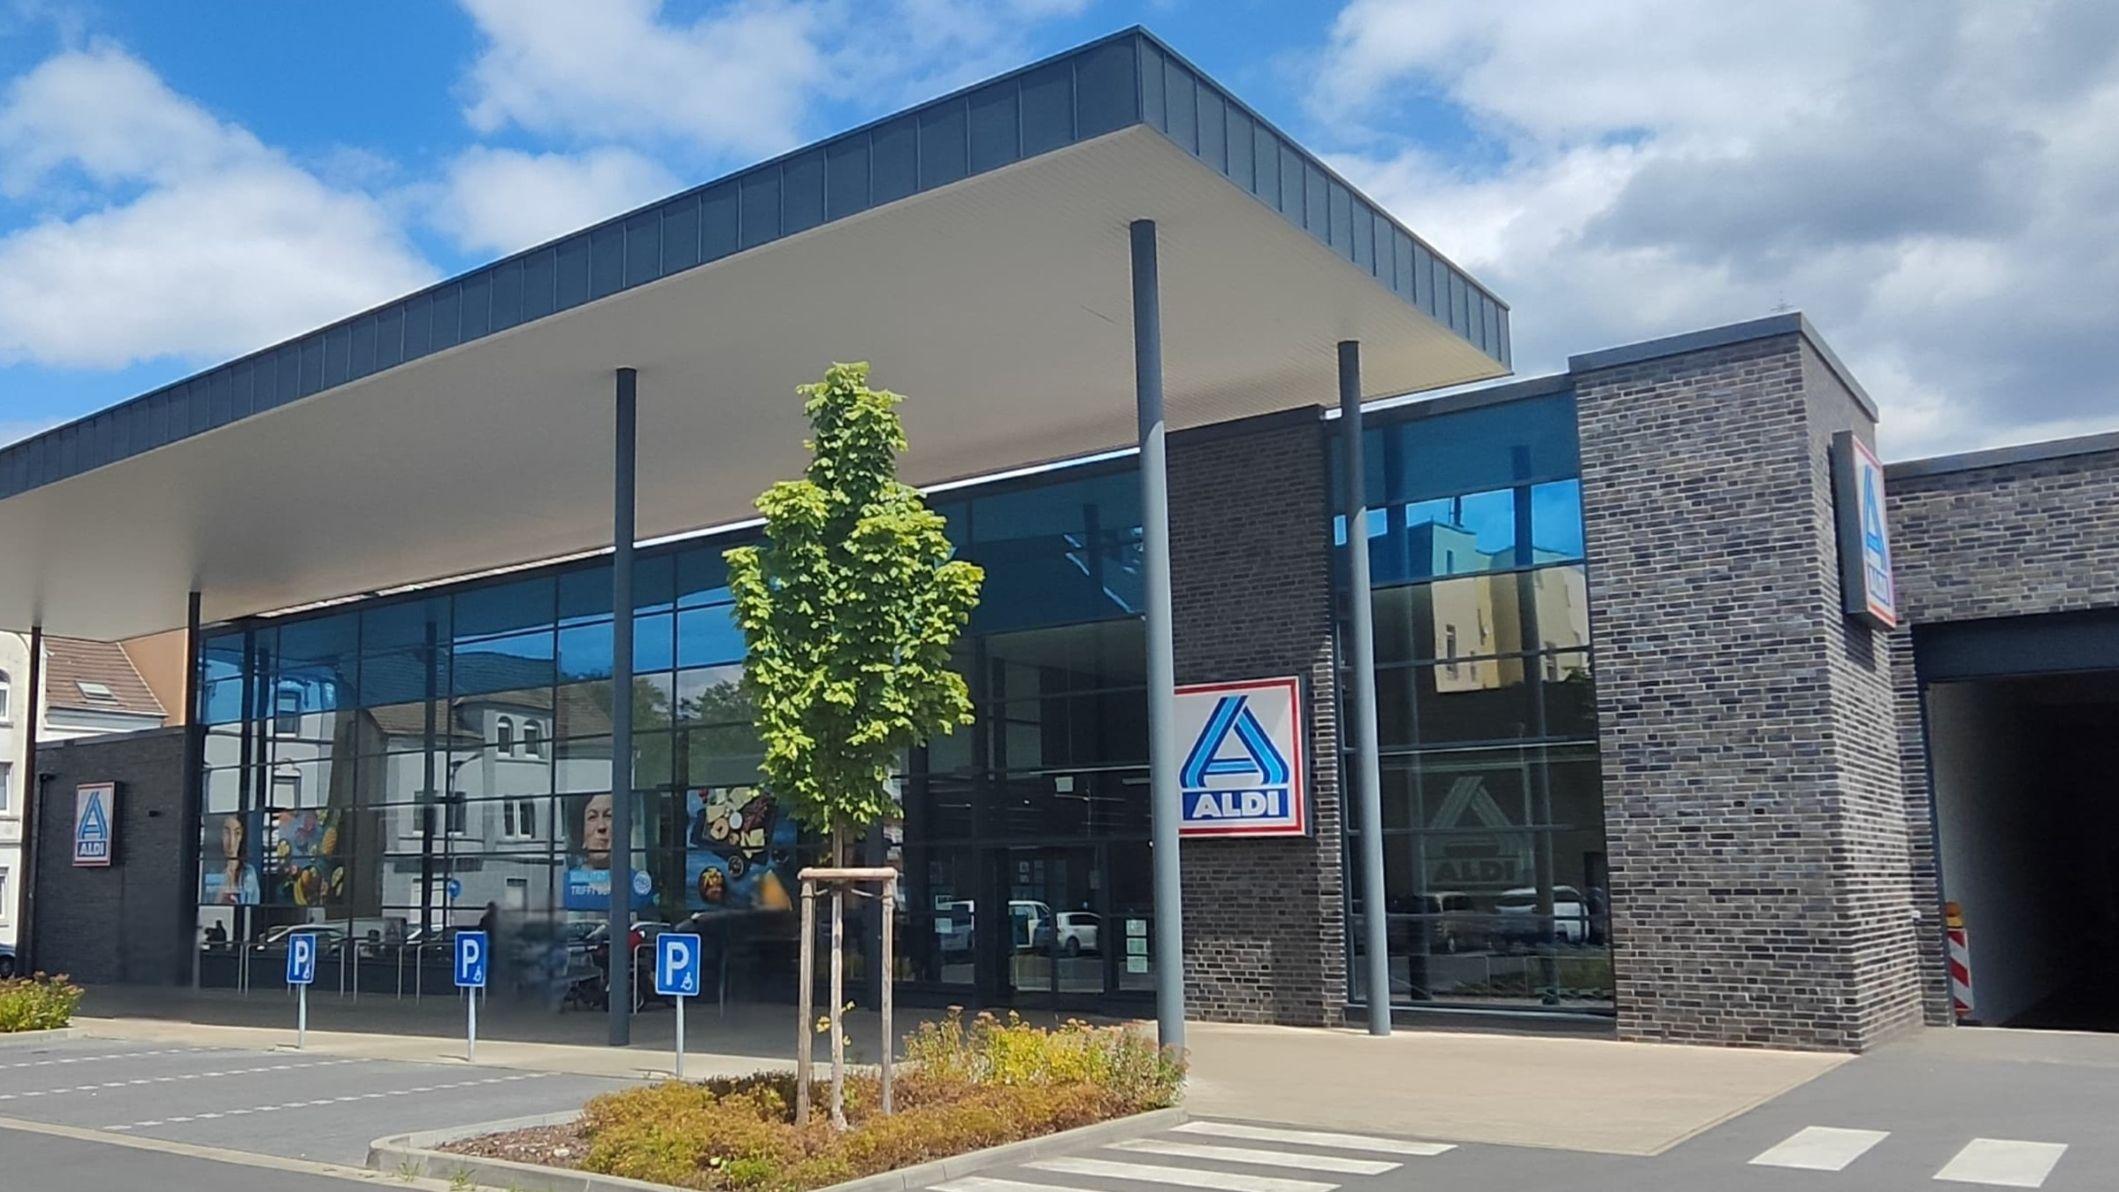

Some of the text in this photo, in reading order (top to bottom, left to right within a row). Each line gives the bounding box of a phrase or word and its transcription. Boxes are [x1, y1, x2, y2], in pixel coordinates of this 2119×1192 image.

[1192, 790, 1280, 818] ALDI
[80, 842, 105, 856] ALDI
[294, 940, 309, 976] P
[462, 939, 479, 979] P
[666, 941, 689, 986] P
